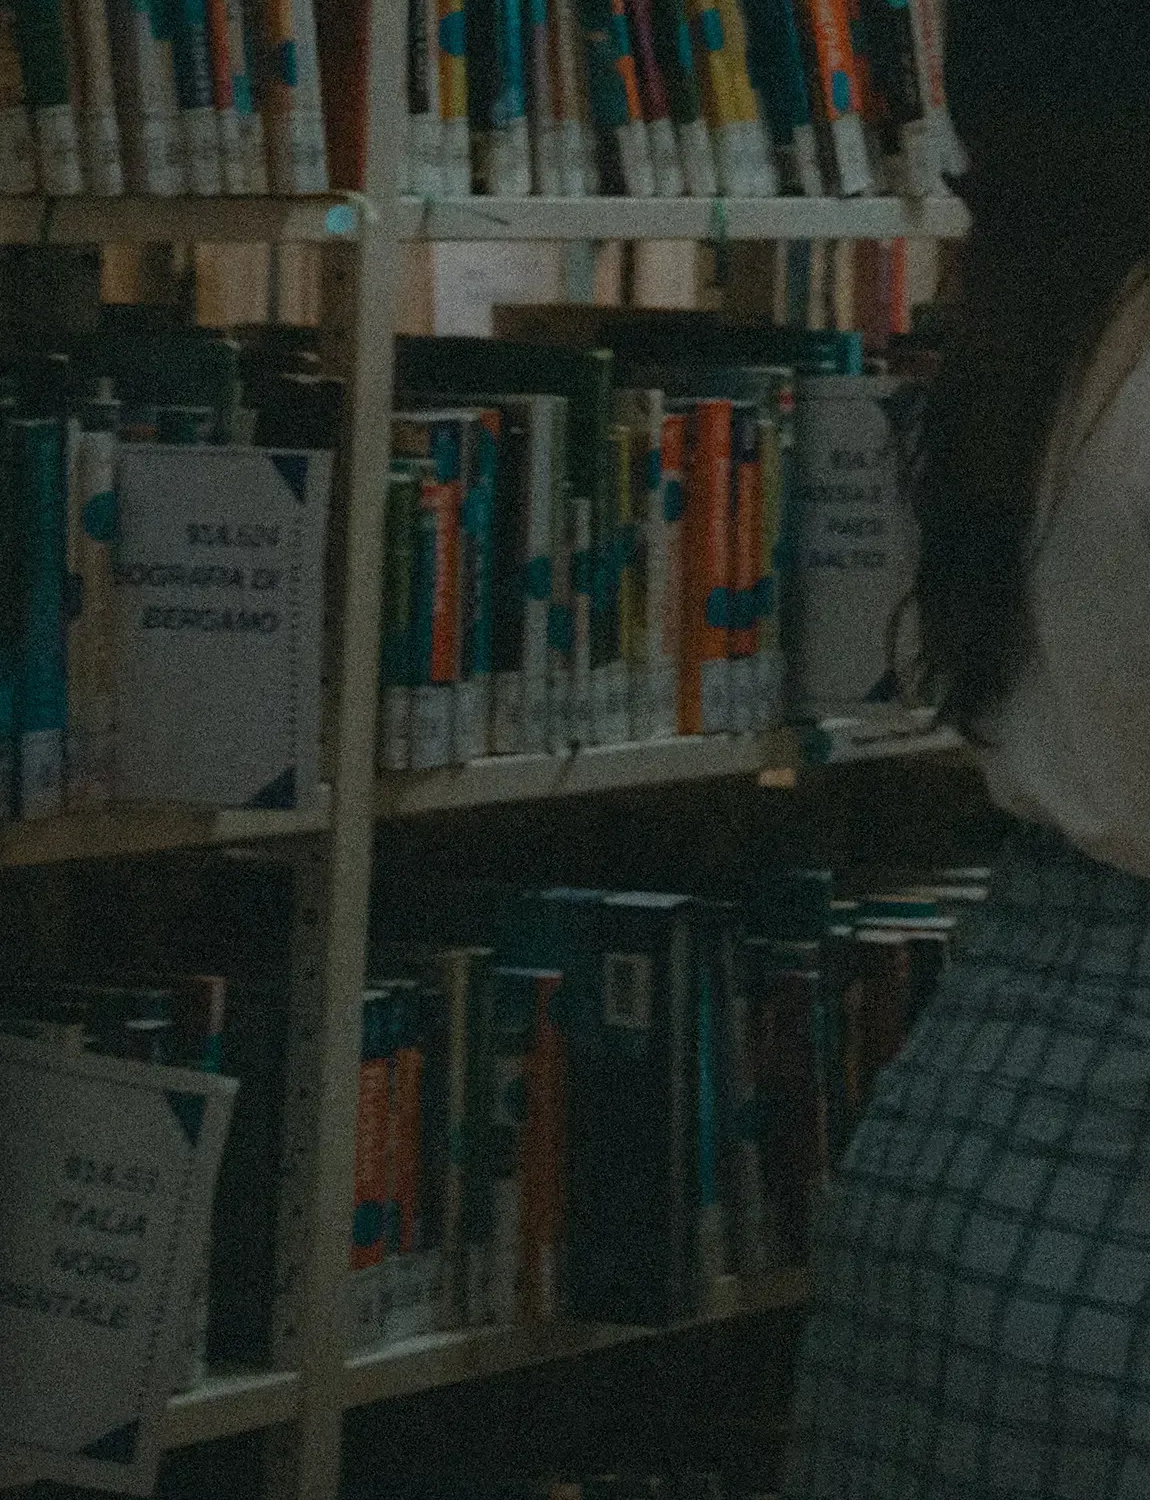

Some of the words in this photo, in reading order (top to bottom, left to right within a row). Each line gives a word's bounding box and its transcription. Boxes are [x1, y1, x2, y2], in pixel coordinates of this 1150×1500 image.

[143, 604, 281, 635] BERGAMO
[49, 1198, 149, 1238] ITALIA
[50, 1245, 143, 1286] NORD
